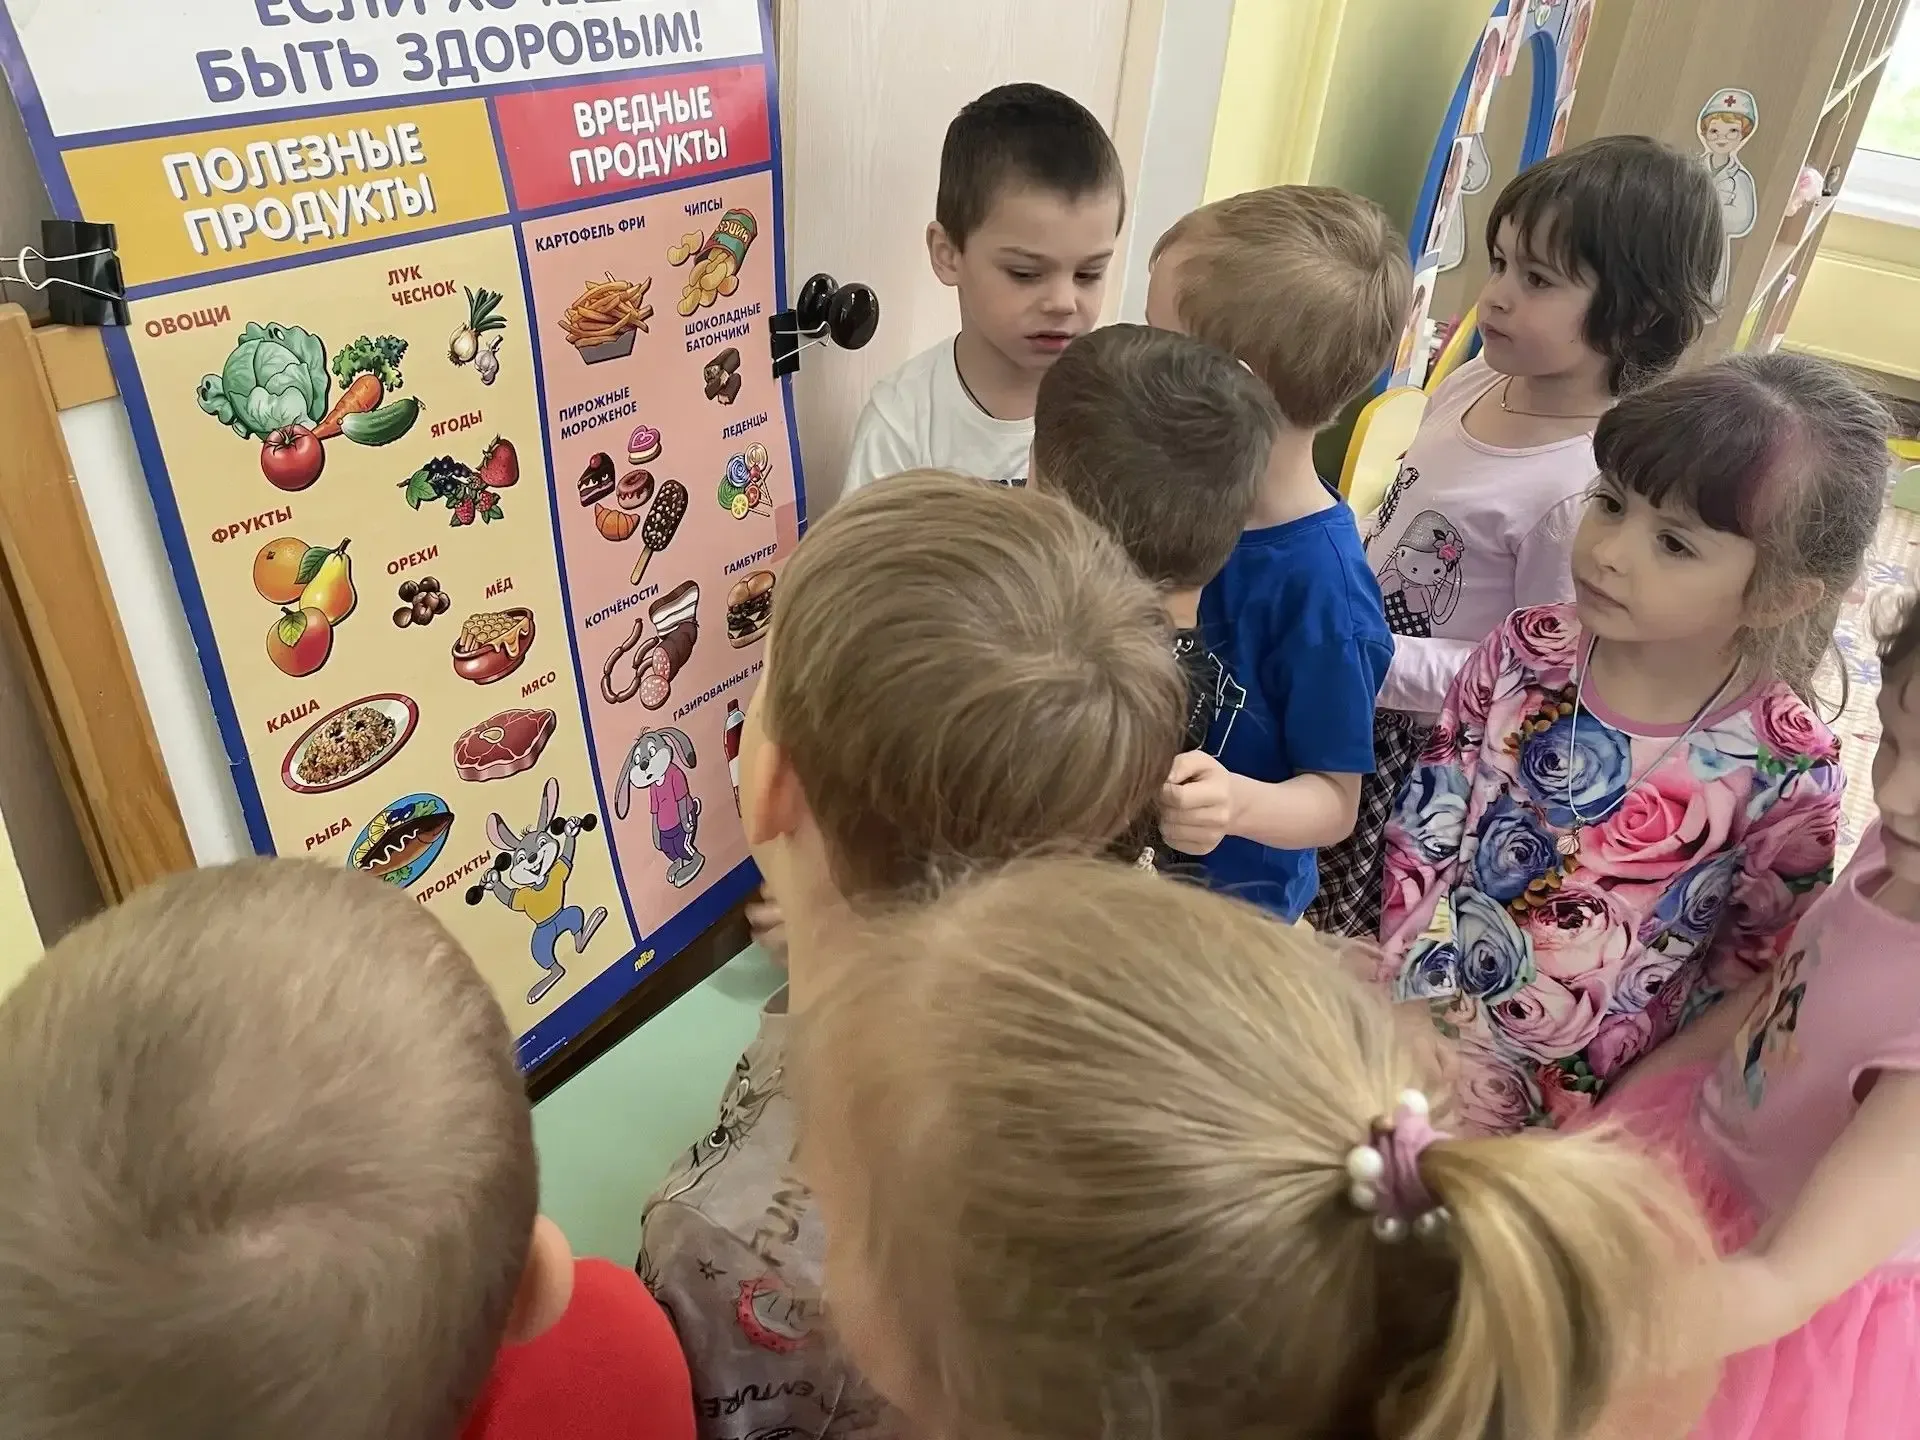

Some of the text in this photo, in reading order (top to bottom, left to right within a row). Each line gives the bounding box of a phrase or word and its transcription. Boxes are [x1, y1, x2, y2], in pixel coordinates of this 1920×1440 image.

[196, 9, 703, 103] БЫТЬ ЗДОРОВЫМ!
[573, 85, 713, 138] ВРЕДНЫЕ
[162, 122, 427, 200] ПОЛЕЗНЫЕ
[569, 125, 728, 187] ПРОДУКТЫ
[184, 172, 437, 256] ПРОДУКТЫ
[684, 197, 723, 217] ЧИПСЫ
[535, 215, 645, 252] КАРТОФЕЛЬ ФРИ
[388, 265, 423, 286] ЛУК
[391, 280, 457, 307] ЧЕСНОК
[145, 305, 232, 338] ОВОЩИ
[685, 302, 761, 336] ШОКОЛАДНЫЕ
[686, 322, 750, 353] БАТОНЧИКИ
[559, 386, 631, 423] ПИРОЖНЫЕ
[561, 401, 638, 440] МОРОЖЕНОЕ
[430, 410, 483, 438] ЯГОДЫ
[722, 411, 769, 439] ЛЕДЕНЦЫ
[211, 506, 293, 544] ФРУКТЫ
[387, 545, 439, 575] ОРЕХИ
[723, 543, 778, 575] ГАМБУРГЕР
[485, 576, 514, 599] МЁД
[584, 583, 659, 629] КОПЧЁНОСТИ
[521, 671, 556, 698] МЯСО
[673, 668, 749, 722] ГАЗИРОВАННЫЕ
[266, 698, 320, 734] КАША
[304, 817, 352, 851] РЫБА
[416, 850, 491, 904] ПРОДУКТЫ
